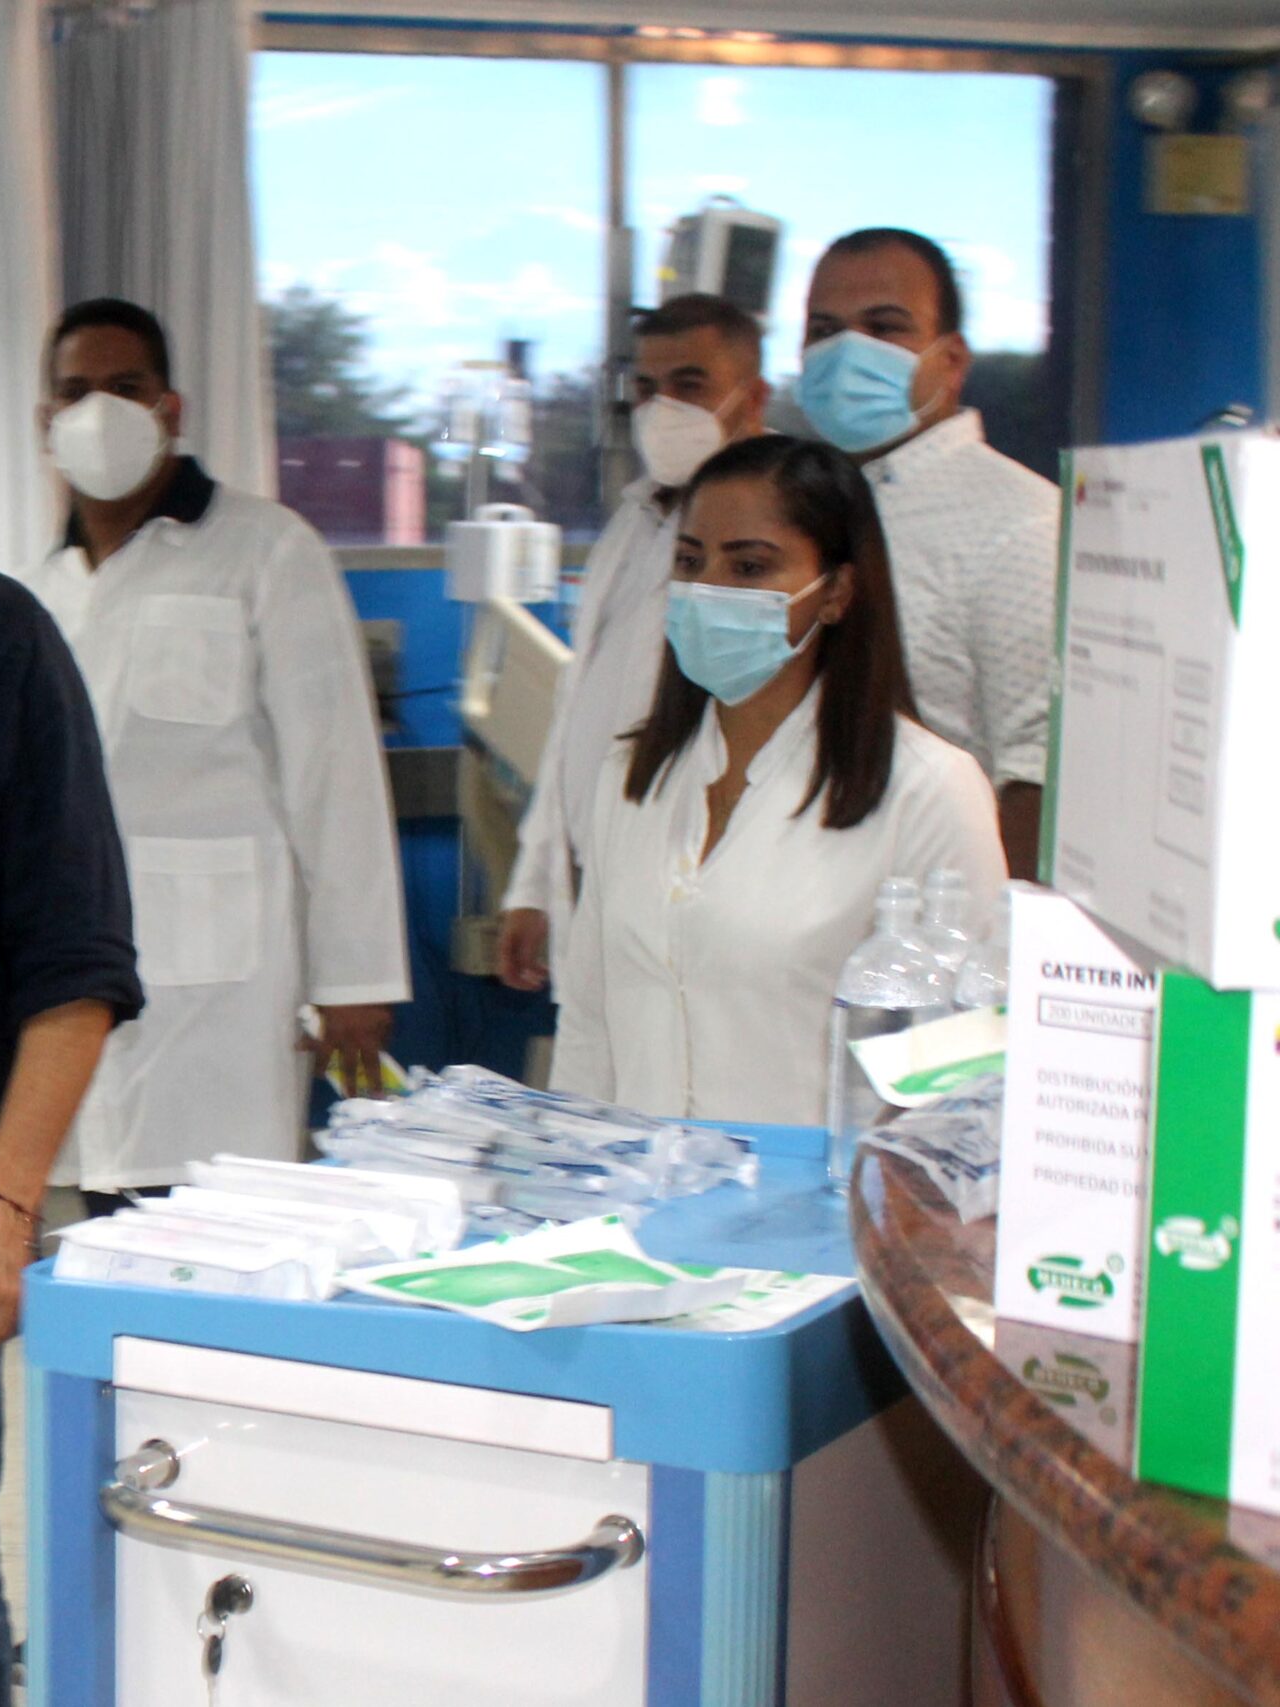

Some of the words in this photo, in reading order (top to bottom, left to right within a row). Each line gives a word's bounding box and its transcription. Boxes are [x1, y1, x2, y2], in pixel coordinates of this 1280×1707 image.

[1042, 962, 1122, 988] CATETER
[1036, 1093, 1129, 1120] AUTORIZADA
[1035, 1129, 1116, 1156] PROHIBIDA
[1034, 1166, 1119, 1195] PROPIEDAD
